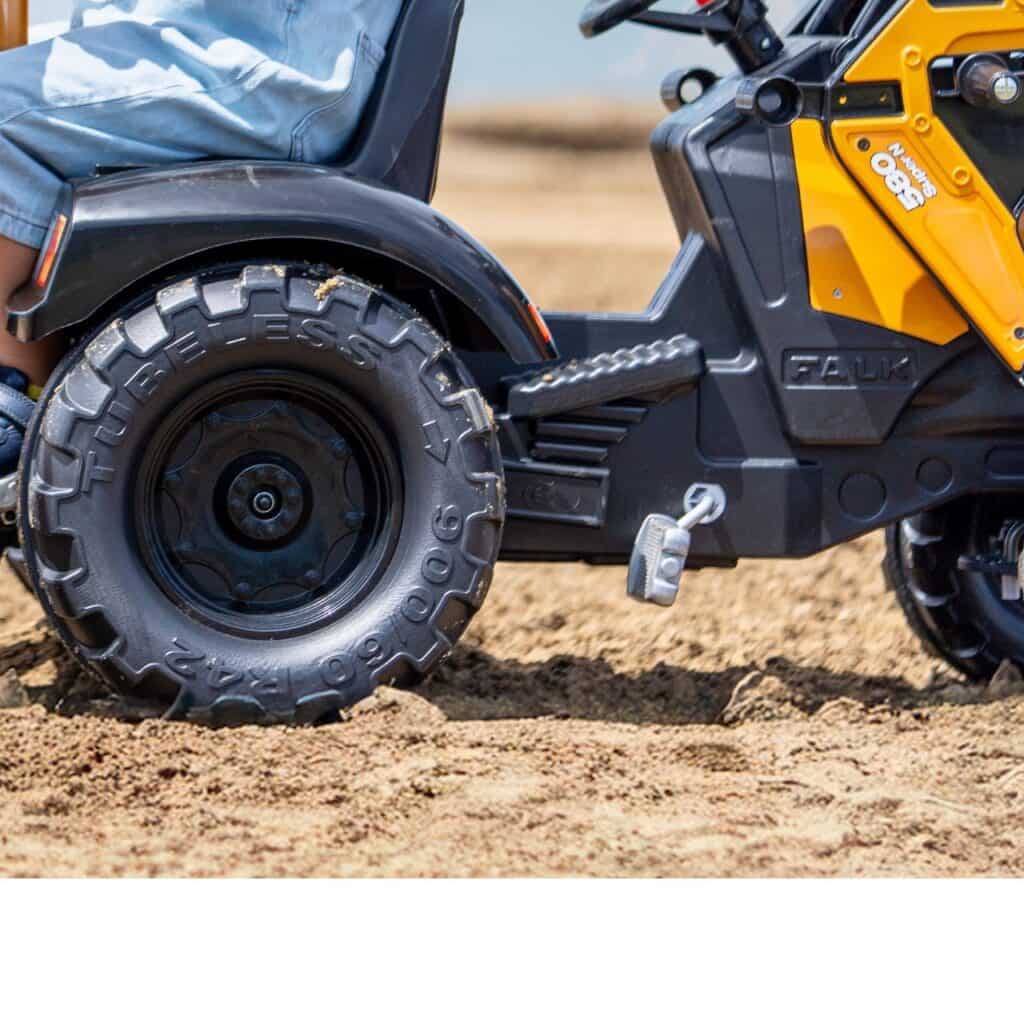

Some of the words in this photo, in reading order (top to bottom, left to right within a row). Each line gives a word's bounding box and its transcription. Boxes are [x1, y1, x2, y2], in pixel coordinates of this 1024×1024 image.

[887, 141, 906, 158] N
[870, 151, 926, 213] 580
[900, 155, 938, 199] Super
[789, 354, 910, 381] FALK
[79, 312, 380, 494] TUBELESS
